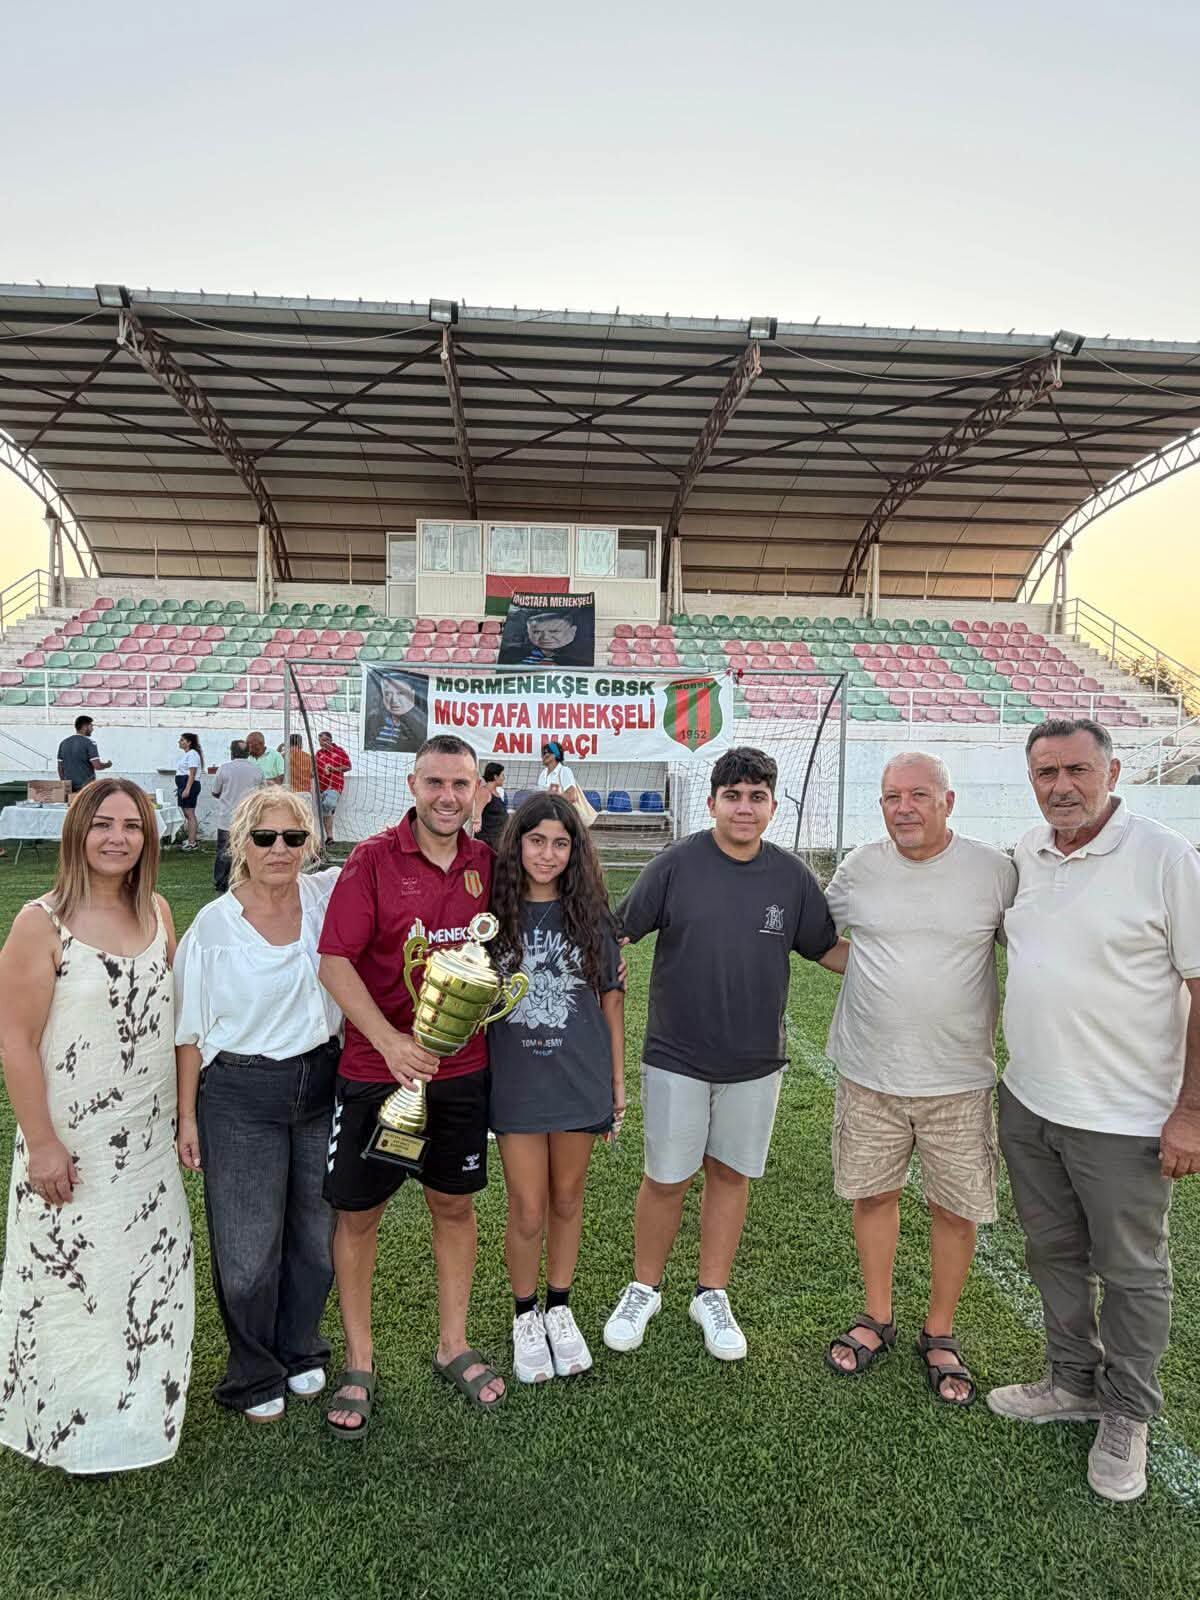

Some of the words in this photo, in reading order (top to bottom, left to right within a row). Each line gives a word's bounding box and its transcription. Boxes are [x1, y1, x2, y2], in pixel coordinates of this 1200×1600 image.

[512, 594, 548, 608] MUSTAFA
[436, 675, 588, 698] MORMENEKŞE
[595, 679, 655, 696] GBSK
[434, 699, 531, 728] MUSTAFA
[537, 698, 655, 736] MENEKŞELİ
[492, 732, 533, 753] ANI
[680, 729, 707, 740] 1952
[521, 1039, 537, 1048] TOM
